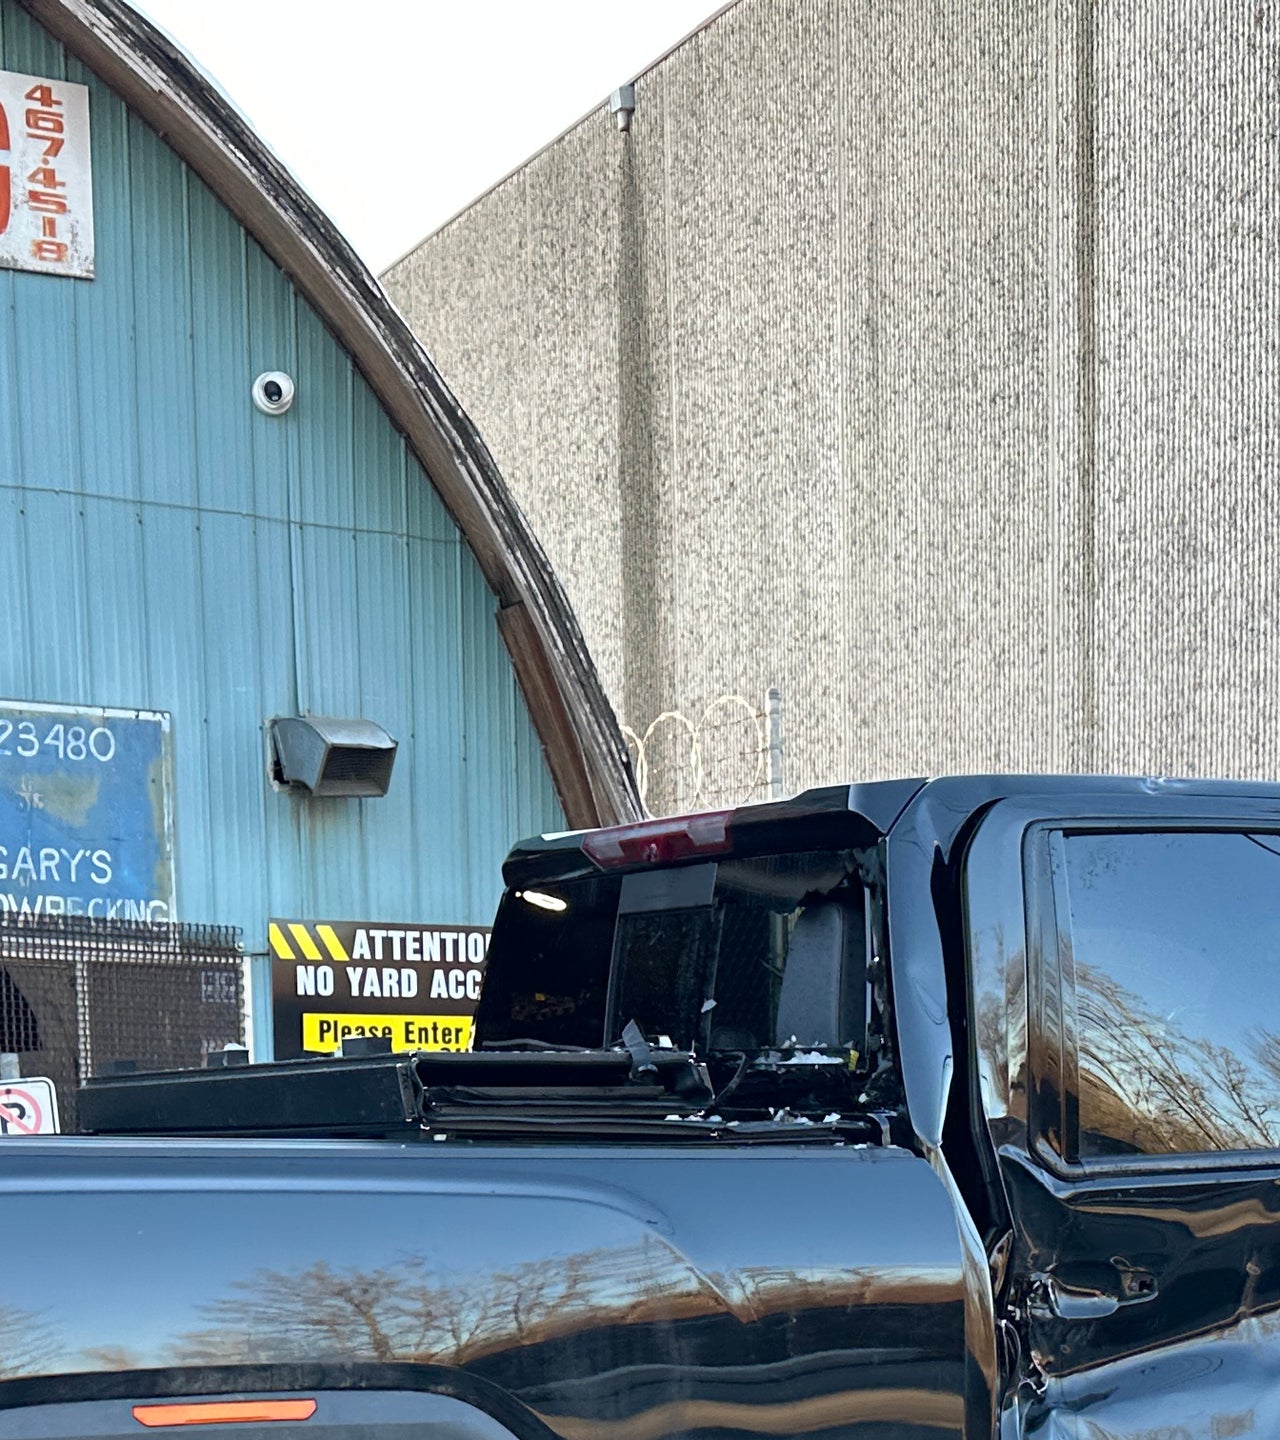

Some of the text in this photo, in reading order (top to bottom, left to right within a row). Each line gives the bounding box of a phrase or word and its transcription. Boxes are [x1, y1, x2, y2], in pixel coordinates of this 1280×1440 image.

[352, 929, 491, 963] ATTENTIO
[297, 965, 334, 996] NO
[346, 966, 418, 998] YARD
[319, 1020, 463, 1045] Please Enter
